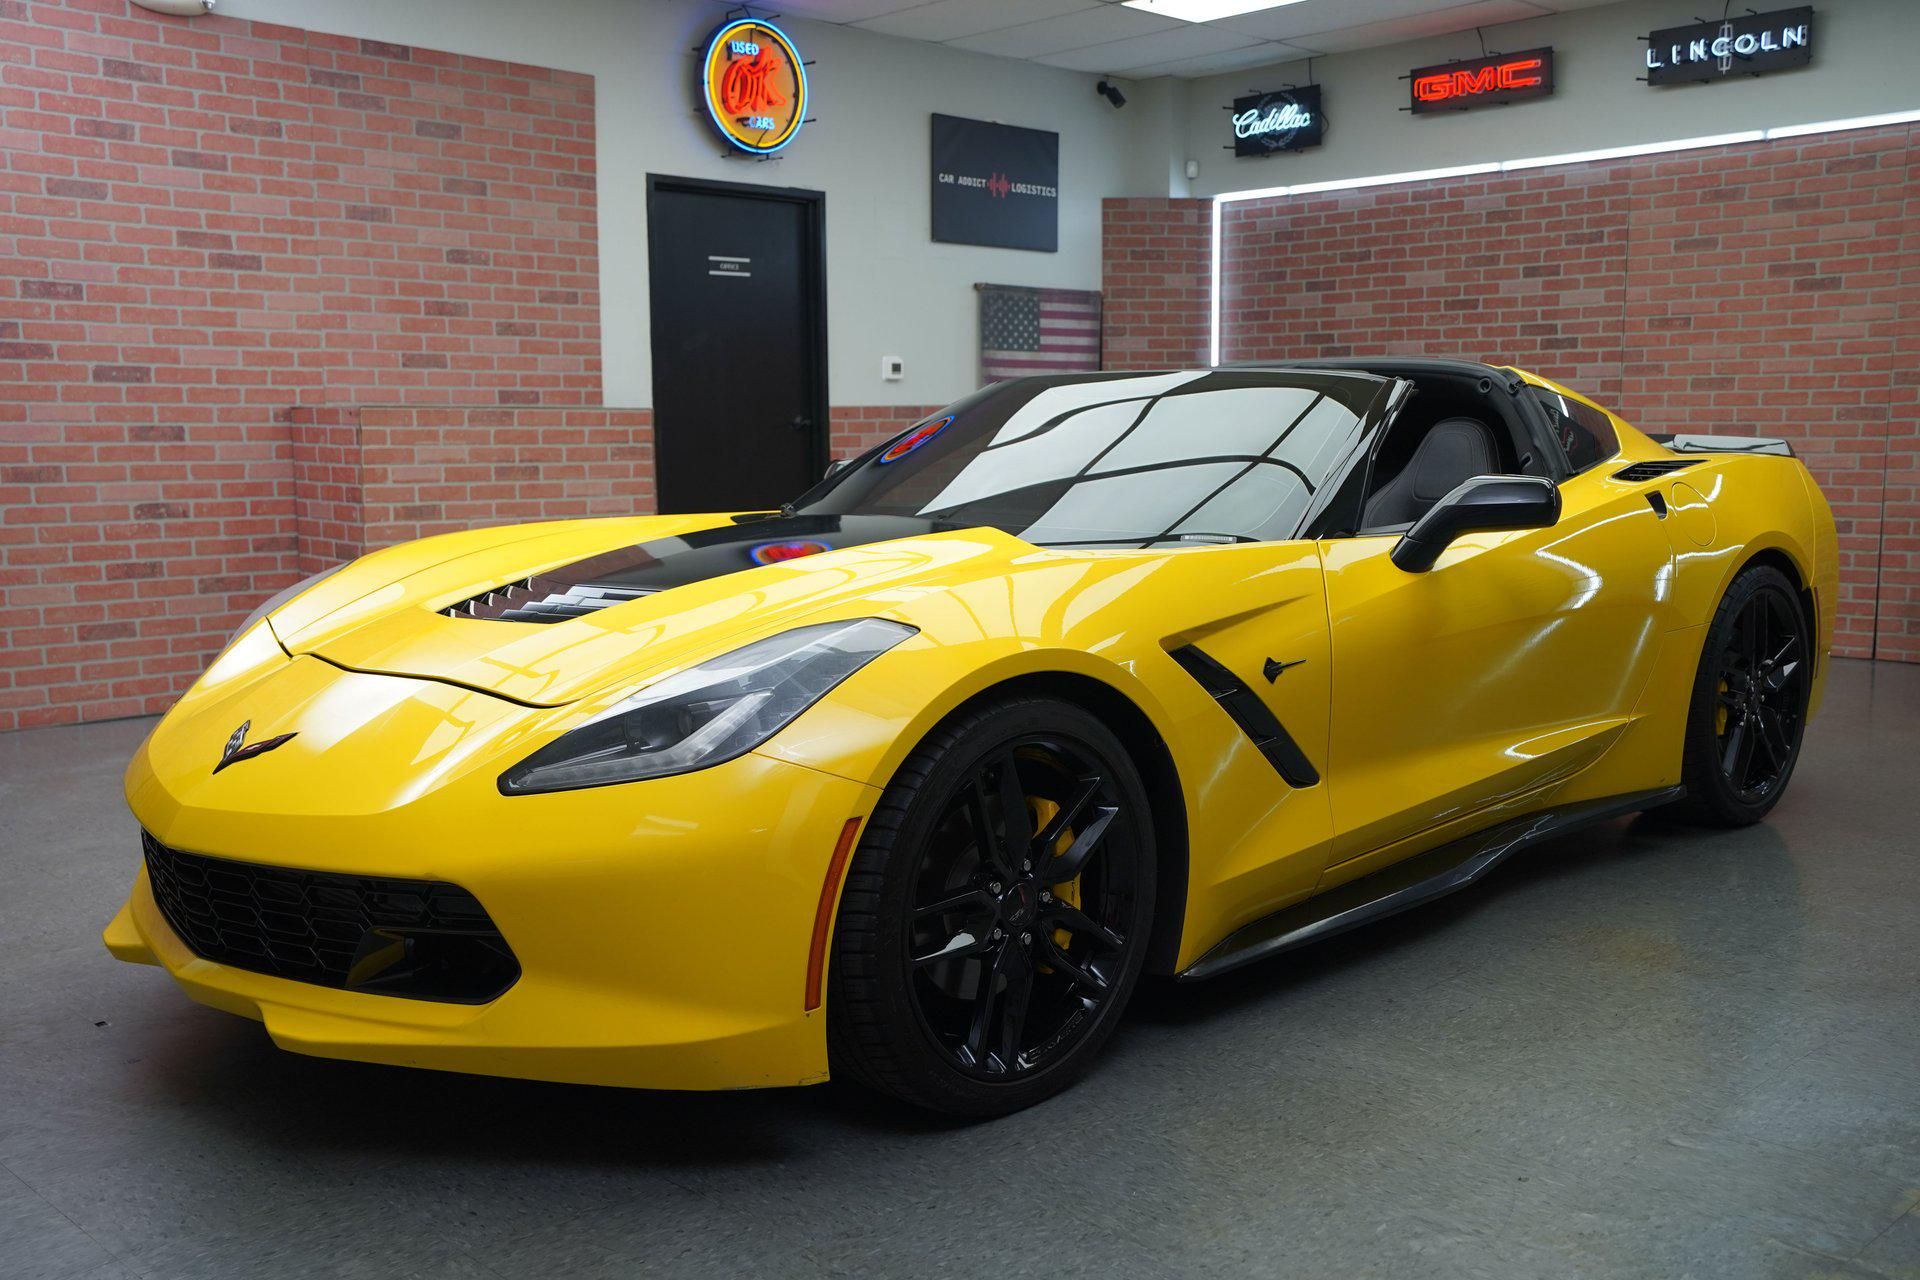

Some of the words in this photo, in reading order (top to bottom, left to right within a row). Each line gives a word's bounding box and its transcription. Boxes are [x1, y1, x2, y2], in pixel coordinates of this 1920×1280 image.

[731, 41, 760, 55] USED
[1646, 24, 1807, 68] LINCOLN
[723, 45, 787, 114] OK
[1413, 58, 1542, 101] GMC
[748, 116, 776, 130] CARS
[1232, 103, 1312, 139] Cadillac
[938, 172, 955, 184] CAR
[957, 175, 987, 188] ADDICT
[1011, 182, 1057, 198] LOGISTICS
